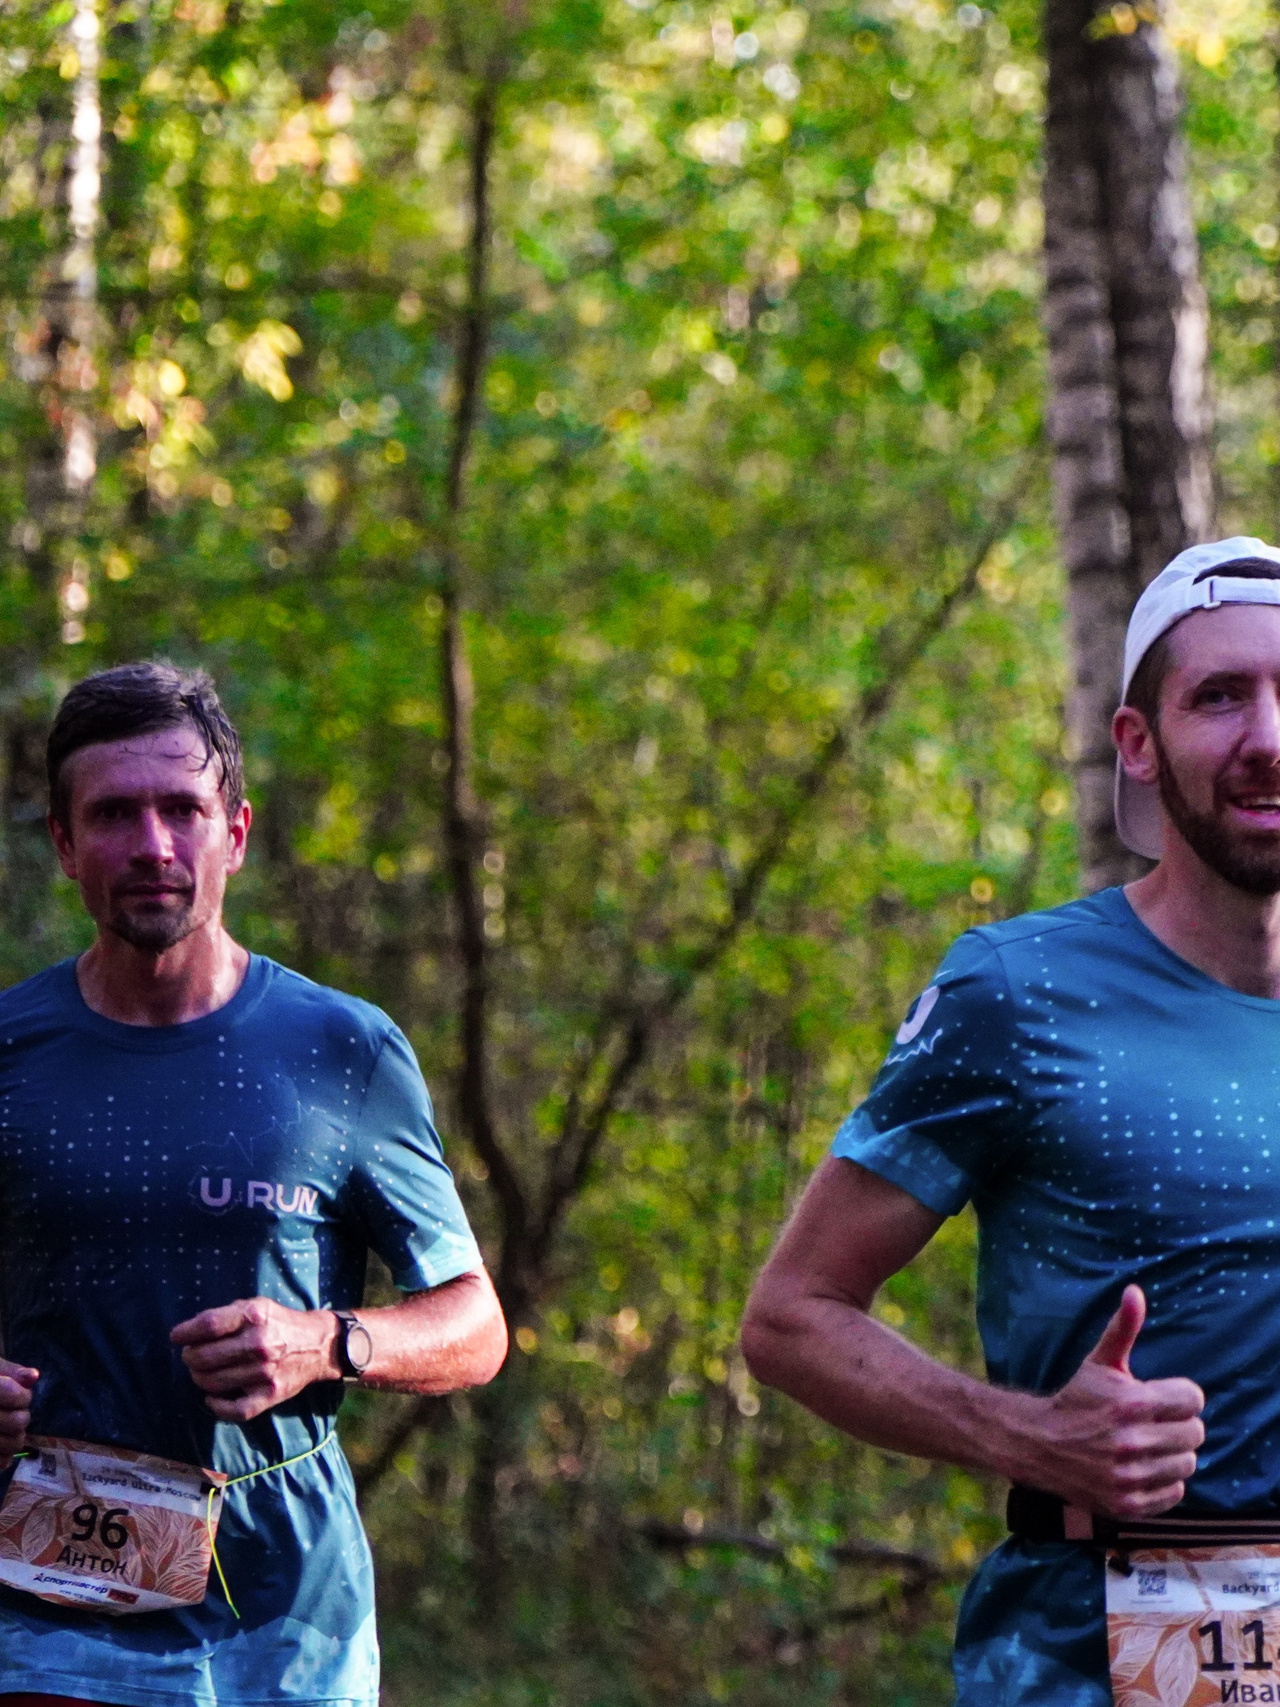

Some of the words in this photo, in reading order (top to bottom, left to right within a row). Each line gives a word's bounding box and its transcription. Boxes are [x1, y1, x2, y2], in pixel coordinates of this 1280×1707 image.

[200, 1177, 231, 1207] U
[247, 1180, 318, 1215] RUN
[71, 1503, 131, 1550] 96
[1222, 1582, 1279, 1596] Backyard
